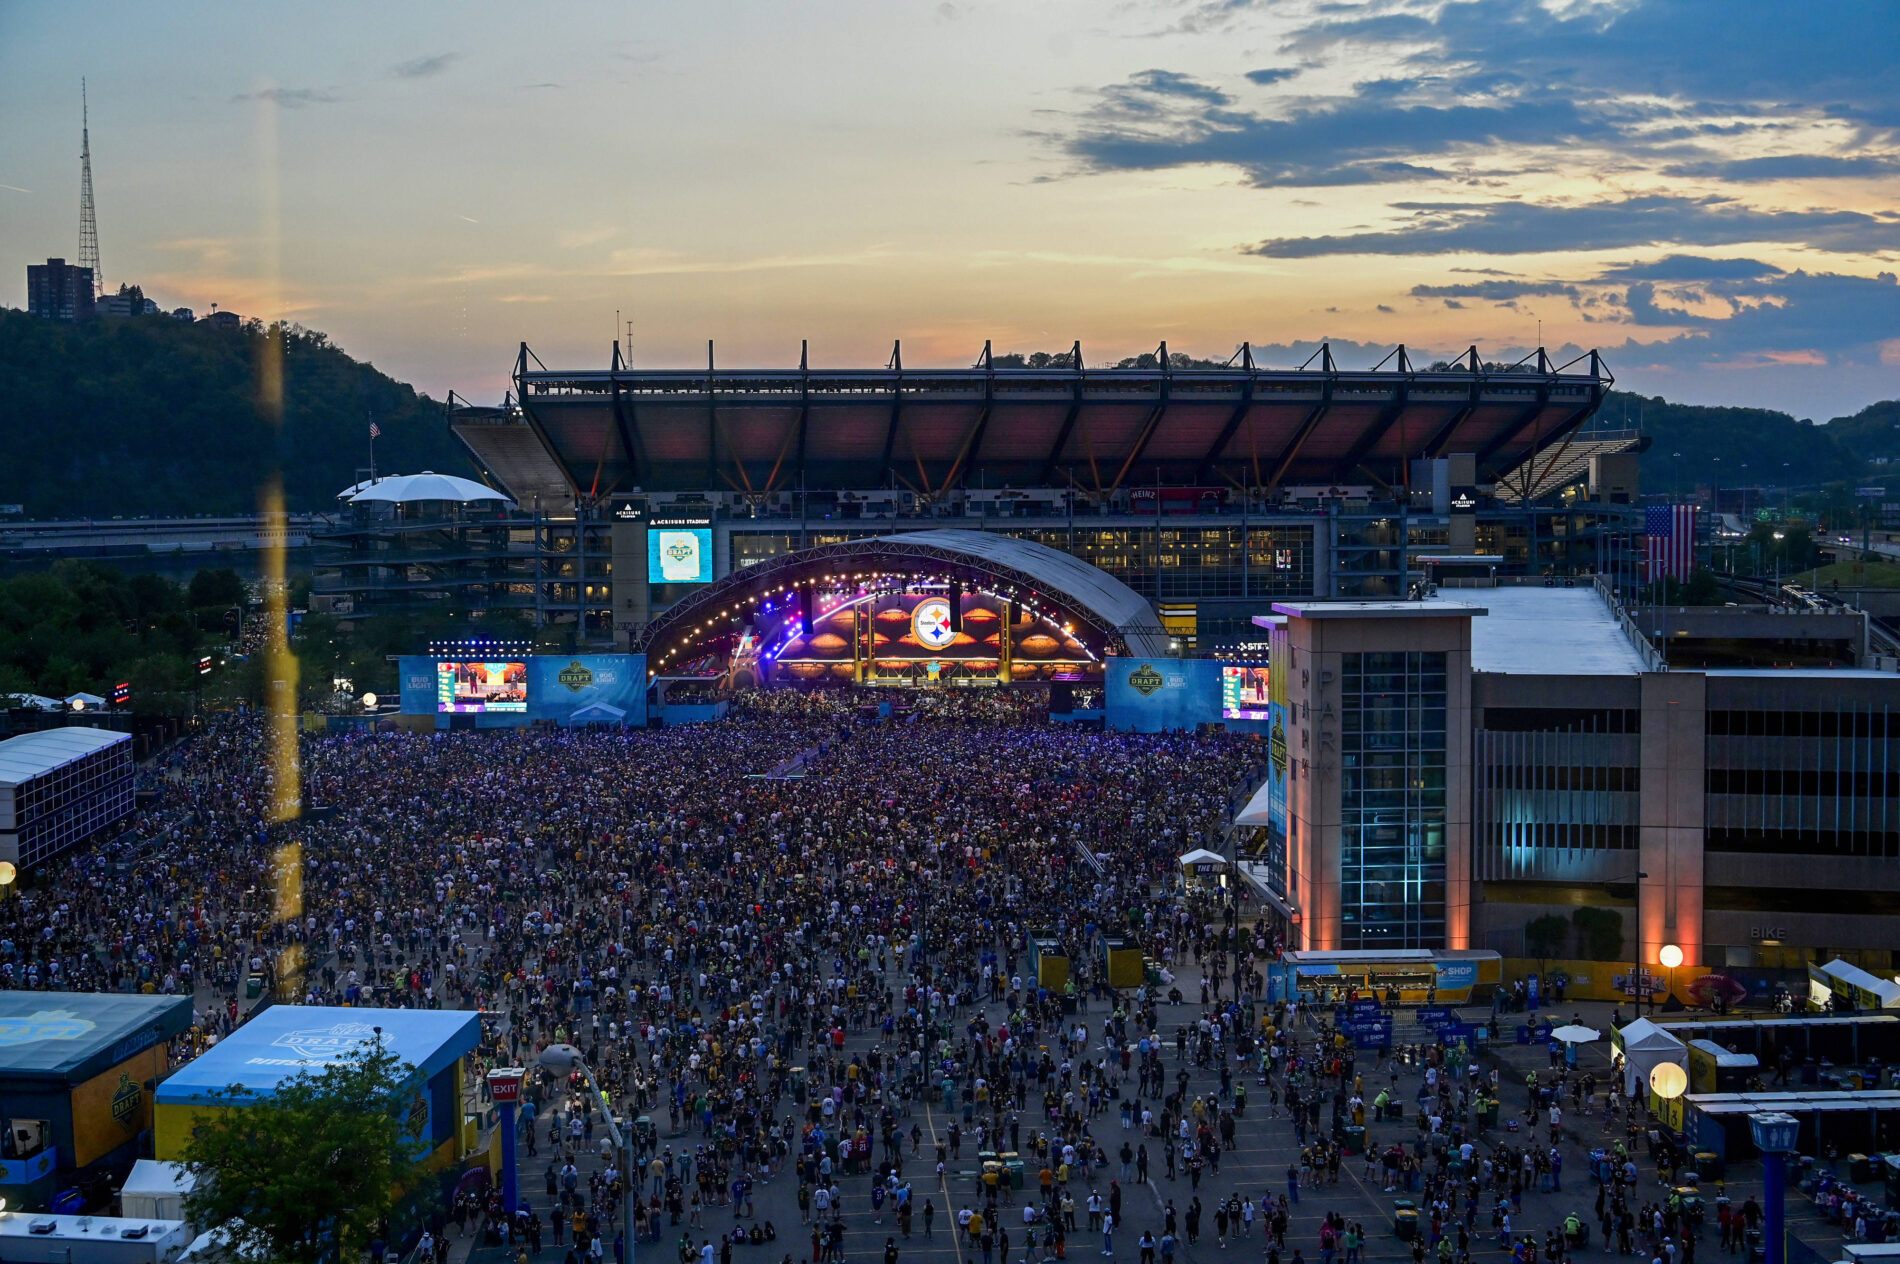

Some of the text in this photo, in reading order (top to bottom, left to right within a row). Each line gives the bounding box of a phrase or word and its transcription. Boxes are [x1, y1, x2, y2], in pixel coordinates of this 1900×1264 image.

[1132, 490, 1155, 499] HEINZ
[1751, 928, 1784, 938] BIKE
[1448, 967, 1472, 975] SHOP
[1613, 975, 1666, 991] PICK
[493, 1084, 517, 1093] EXIT
[113, 1094, 142, 1114] DRAFT
